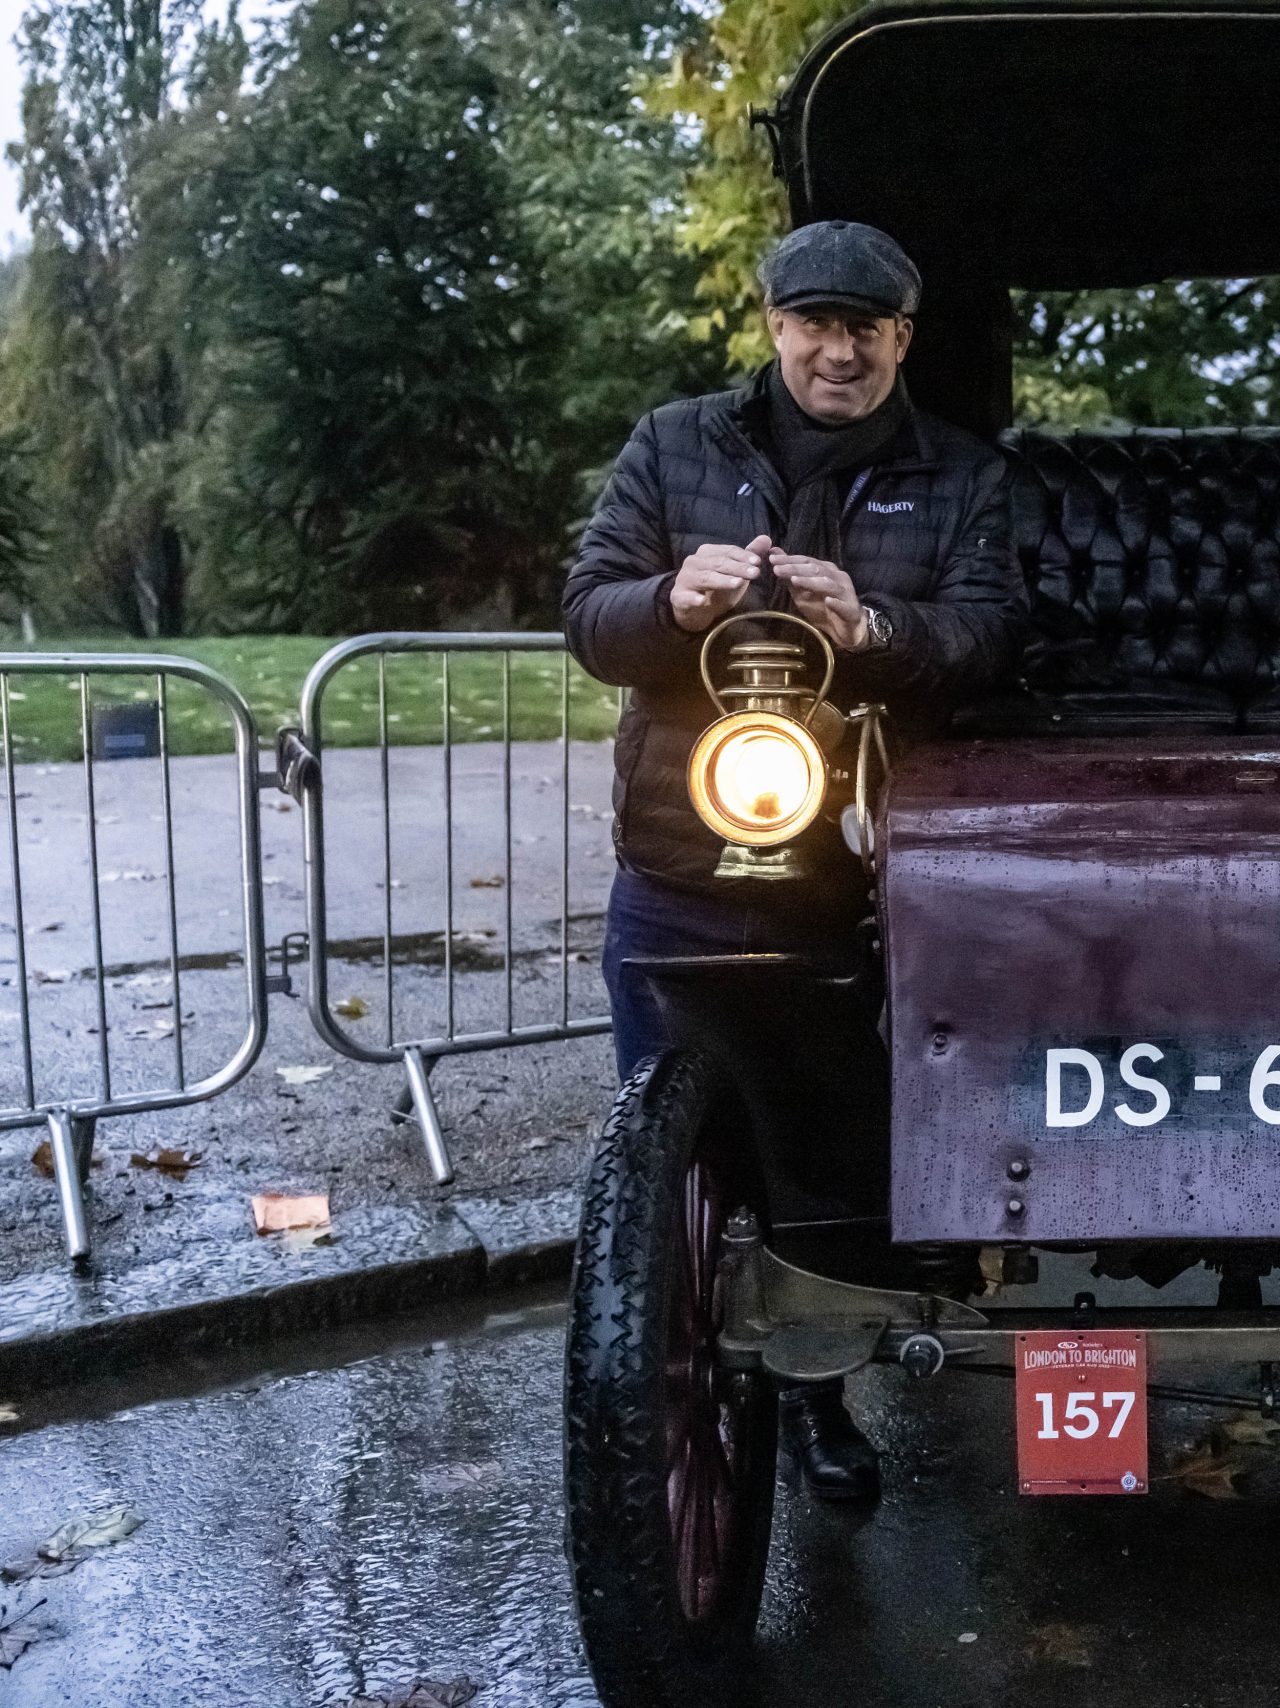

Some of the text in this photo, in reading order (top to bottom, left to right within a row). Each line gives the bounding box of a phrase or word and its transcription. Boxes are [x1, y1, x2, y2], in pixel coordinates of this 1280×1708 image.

[867, 501, 915, 514] HAGERTY
[1046, 1043, 1171, 1127] DS
[1024, 1349, 1137, 1369] LONDON TO BRIGHTON
[1035, 1391, 1136, 1439] 157
